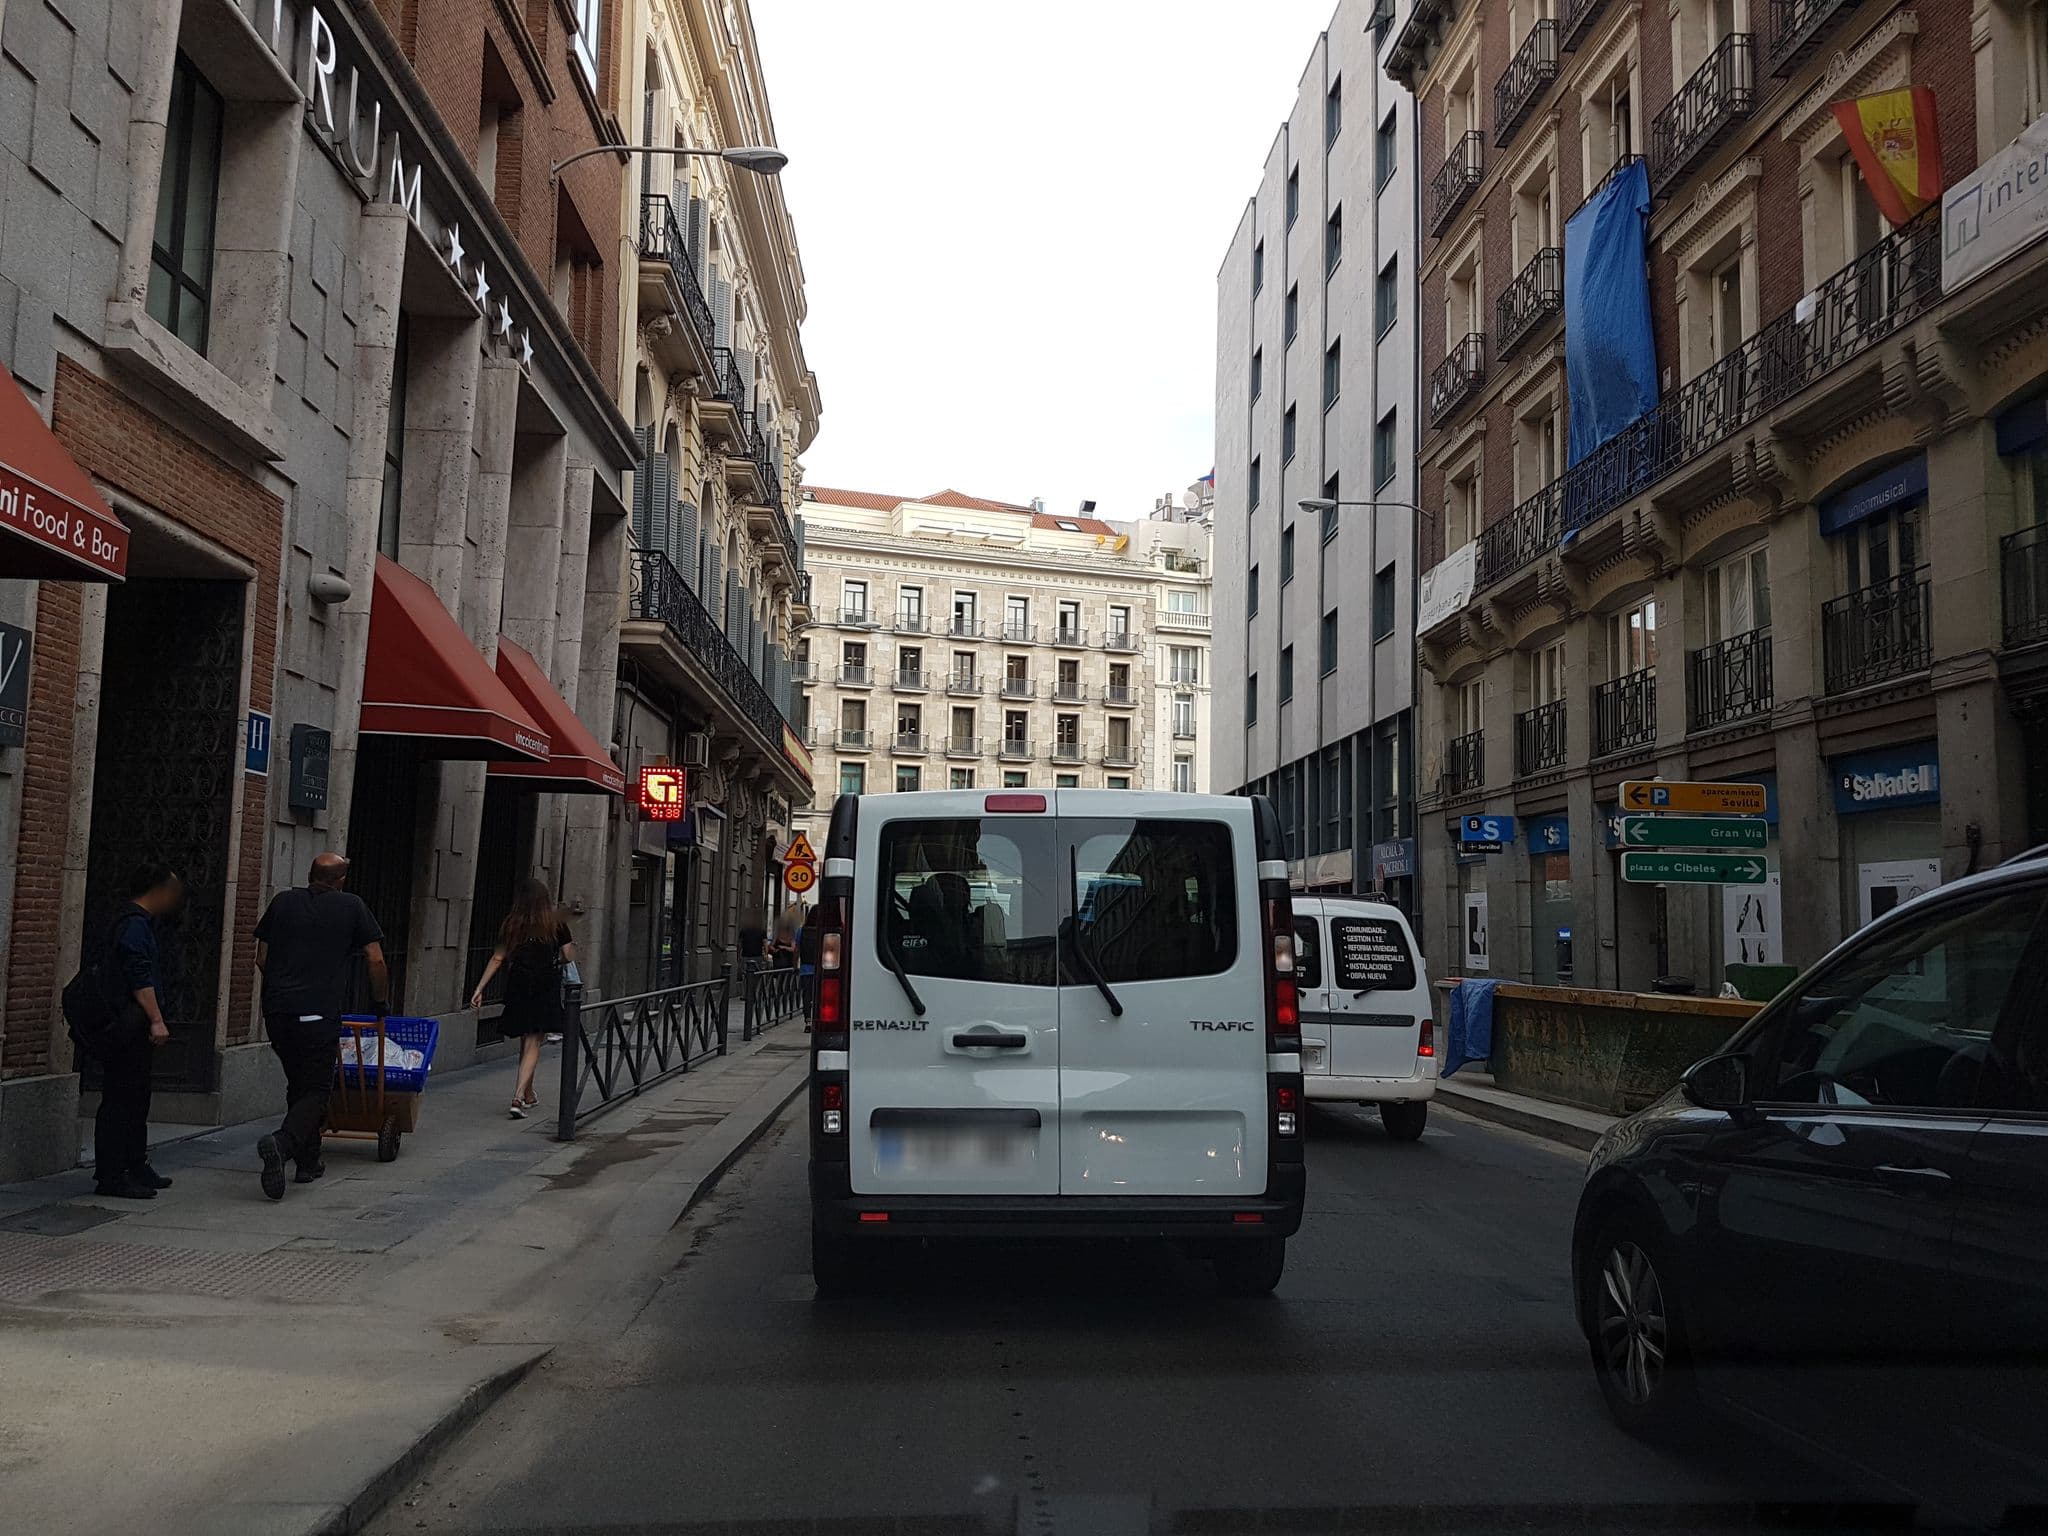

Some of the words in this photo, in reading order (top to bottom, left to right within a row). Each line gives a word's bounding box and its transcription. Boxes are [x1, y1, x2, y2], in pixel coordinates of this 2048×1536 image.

[23, 493, 69, 541] Food
[73, 519, 86, 549] &
[91, 527, 120, 563] Bar
[250, 719, 265, 751] H
[1853, 764, 1936, 801] Sabadell
[1701, 789, 1761, 797] aparcamiento
[1721, 799, 1761, 808] Sevilla
[650, 808, 681, 819] 9:38
[1710, 828, 1740, 839] Gran
[1629, 863, 1654, 873] plaza
[1658, 863, 1670, 873] de
[1673, 862, 1717, 874] Cibeles
[791, 871, 810, 883] 30
[1345, 926, 1387, 934] COMUNIDADES
[1348, 953, 1371, 961] LOCALES
[1349, 962, 1393, 971] INSTALACIONES
[1350, 972, 1367, 980] OBRA
[1367, 972, 1387, 981] NUEVA
[853, 1020, 930, 1031] RENAULT
[1189, 1020, 1255, 1031] TRAFIC
